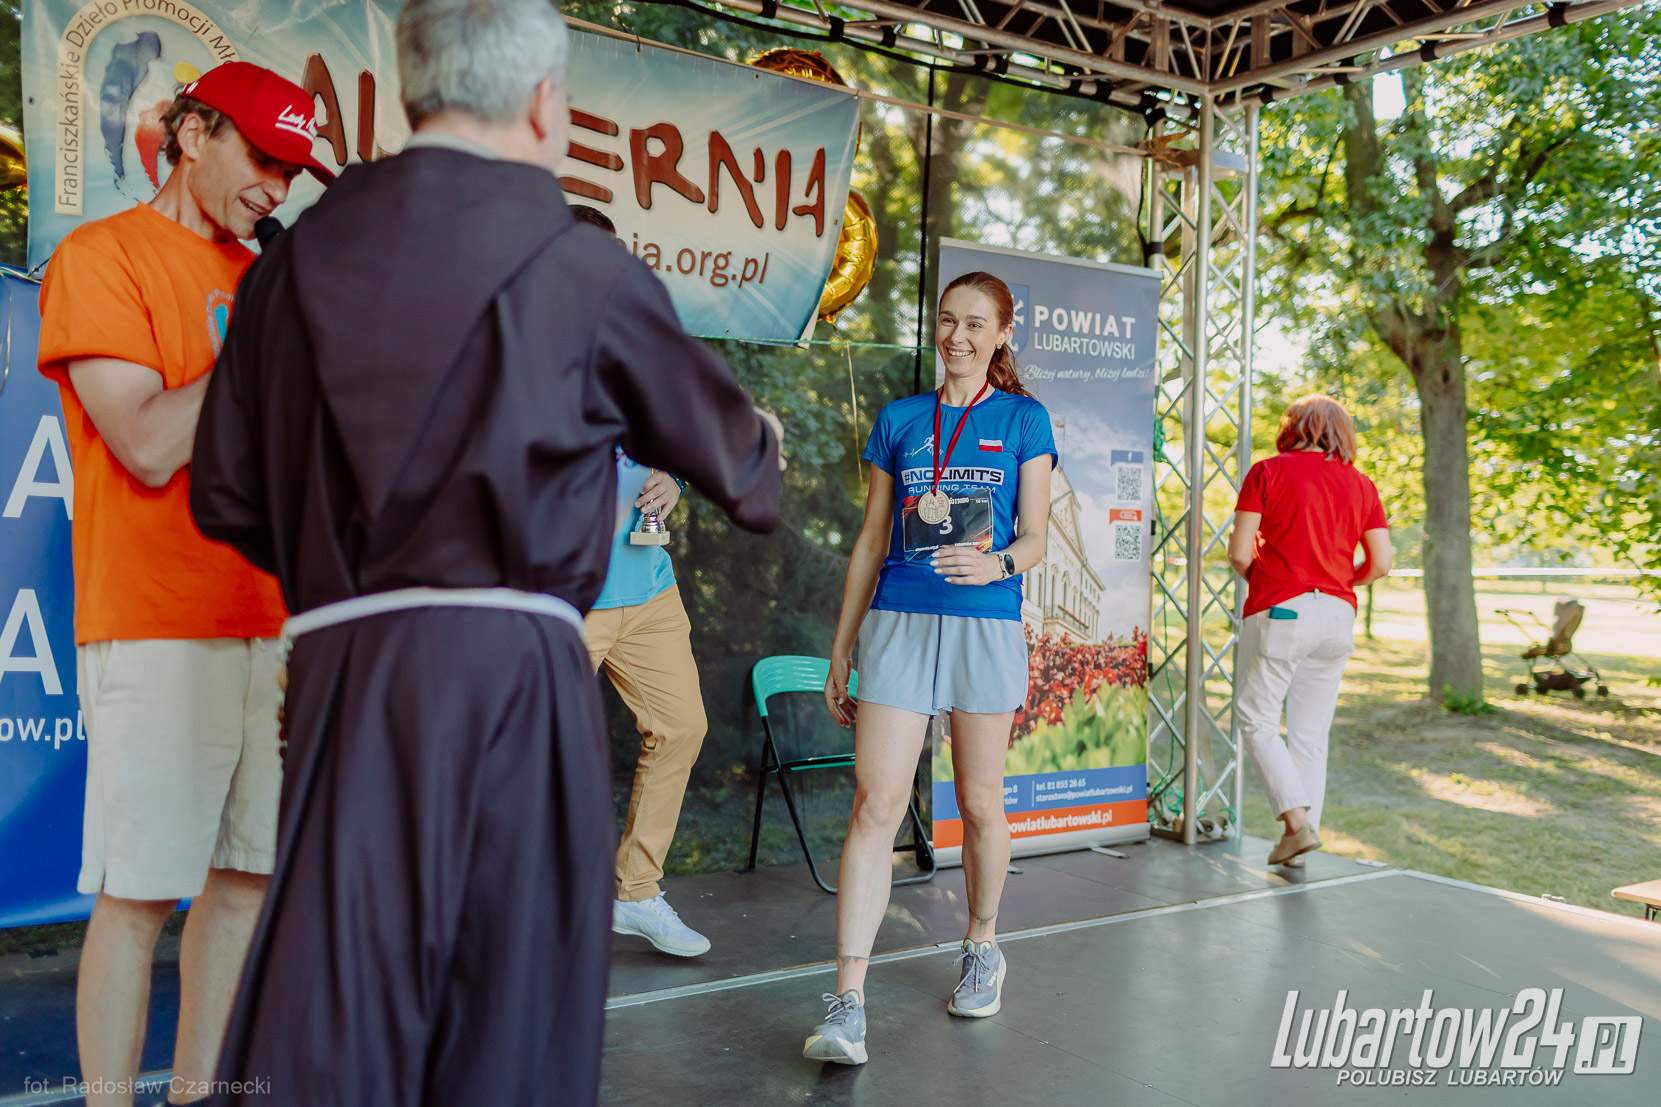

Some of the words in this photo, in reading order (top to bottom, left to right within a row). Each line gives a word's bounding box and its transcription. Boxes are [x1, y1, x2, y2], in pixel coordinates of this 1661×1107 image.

[66, 1, 118, 48] Dzieło
[209, 35, 236, 63] Mł
[58, 51, 81, 207] Franciszkańskie
[618, 232, 769, 288] ia.org.pl
[1034, 305, 1136, 338] POWIAT
[1034, 333, 1136, 360] LUBARTOWSKI
[939, 515, 953, 535] 3
